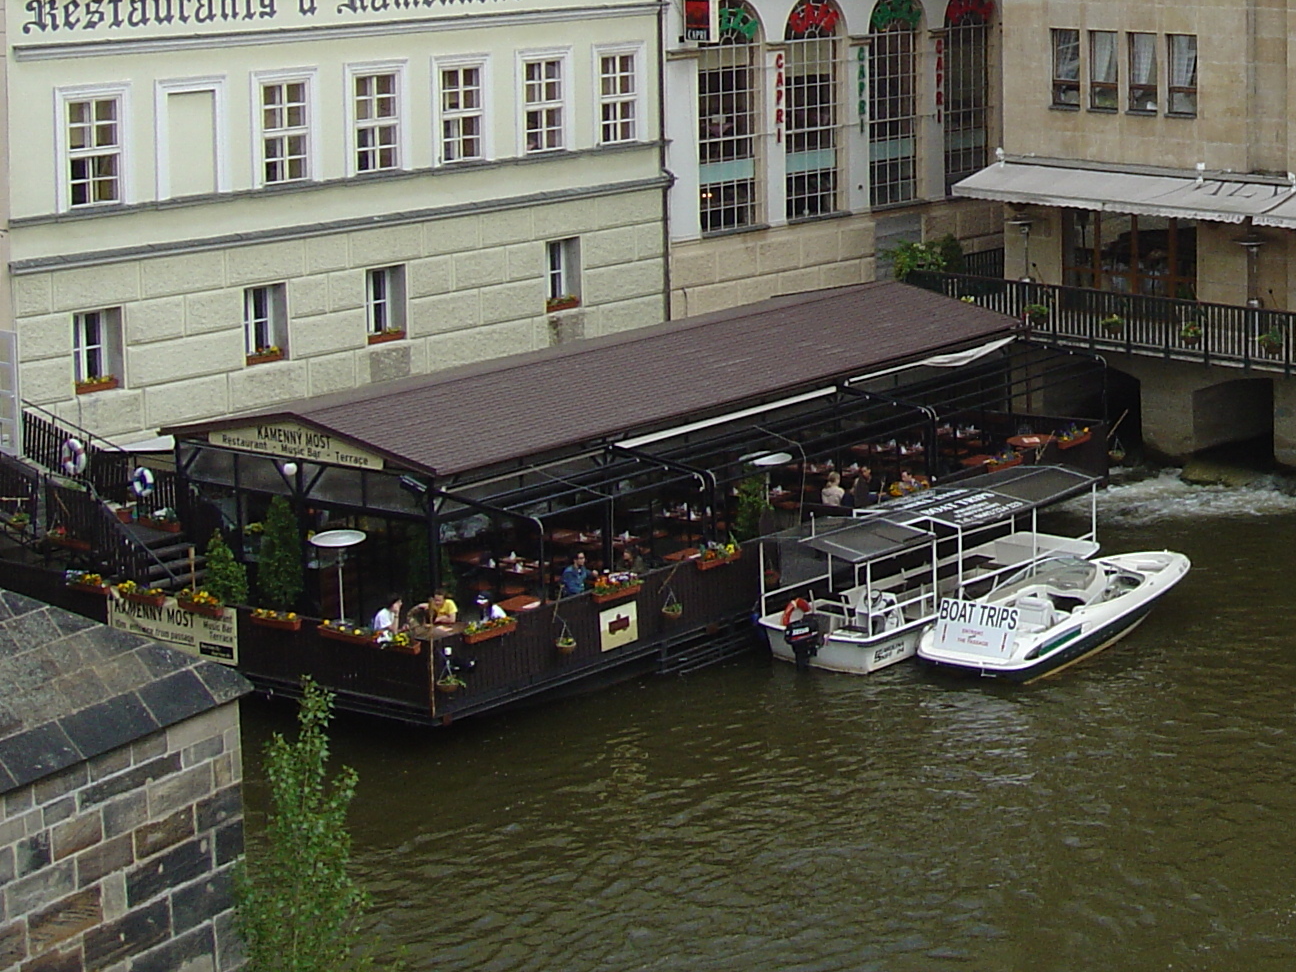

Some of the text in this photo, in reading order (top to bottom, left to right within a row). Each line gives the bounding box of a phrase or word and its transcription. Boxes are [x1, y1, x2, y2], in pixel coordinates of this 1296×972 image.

[687, 29, 708, 40] CAPRI
[858, 46, 866, 134] CAPRI
[935, 39, 943, 124] CAPRI
[775, 53, 785, 144] CAPRI
[222, 434, 369, 466] Restaurant Music Bar Terrace
[306, 433, 331, 449] MOST
[167, 608, 195, 628] MOST
[940, 600, 1018, 630] BOAT TRIPS
